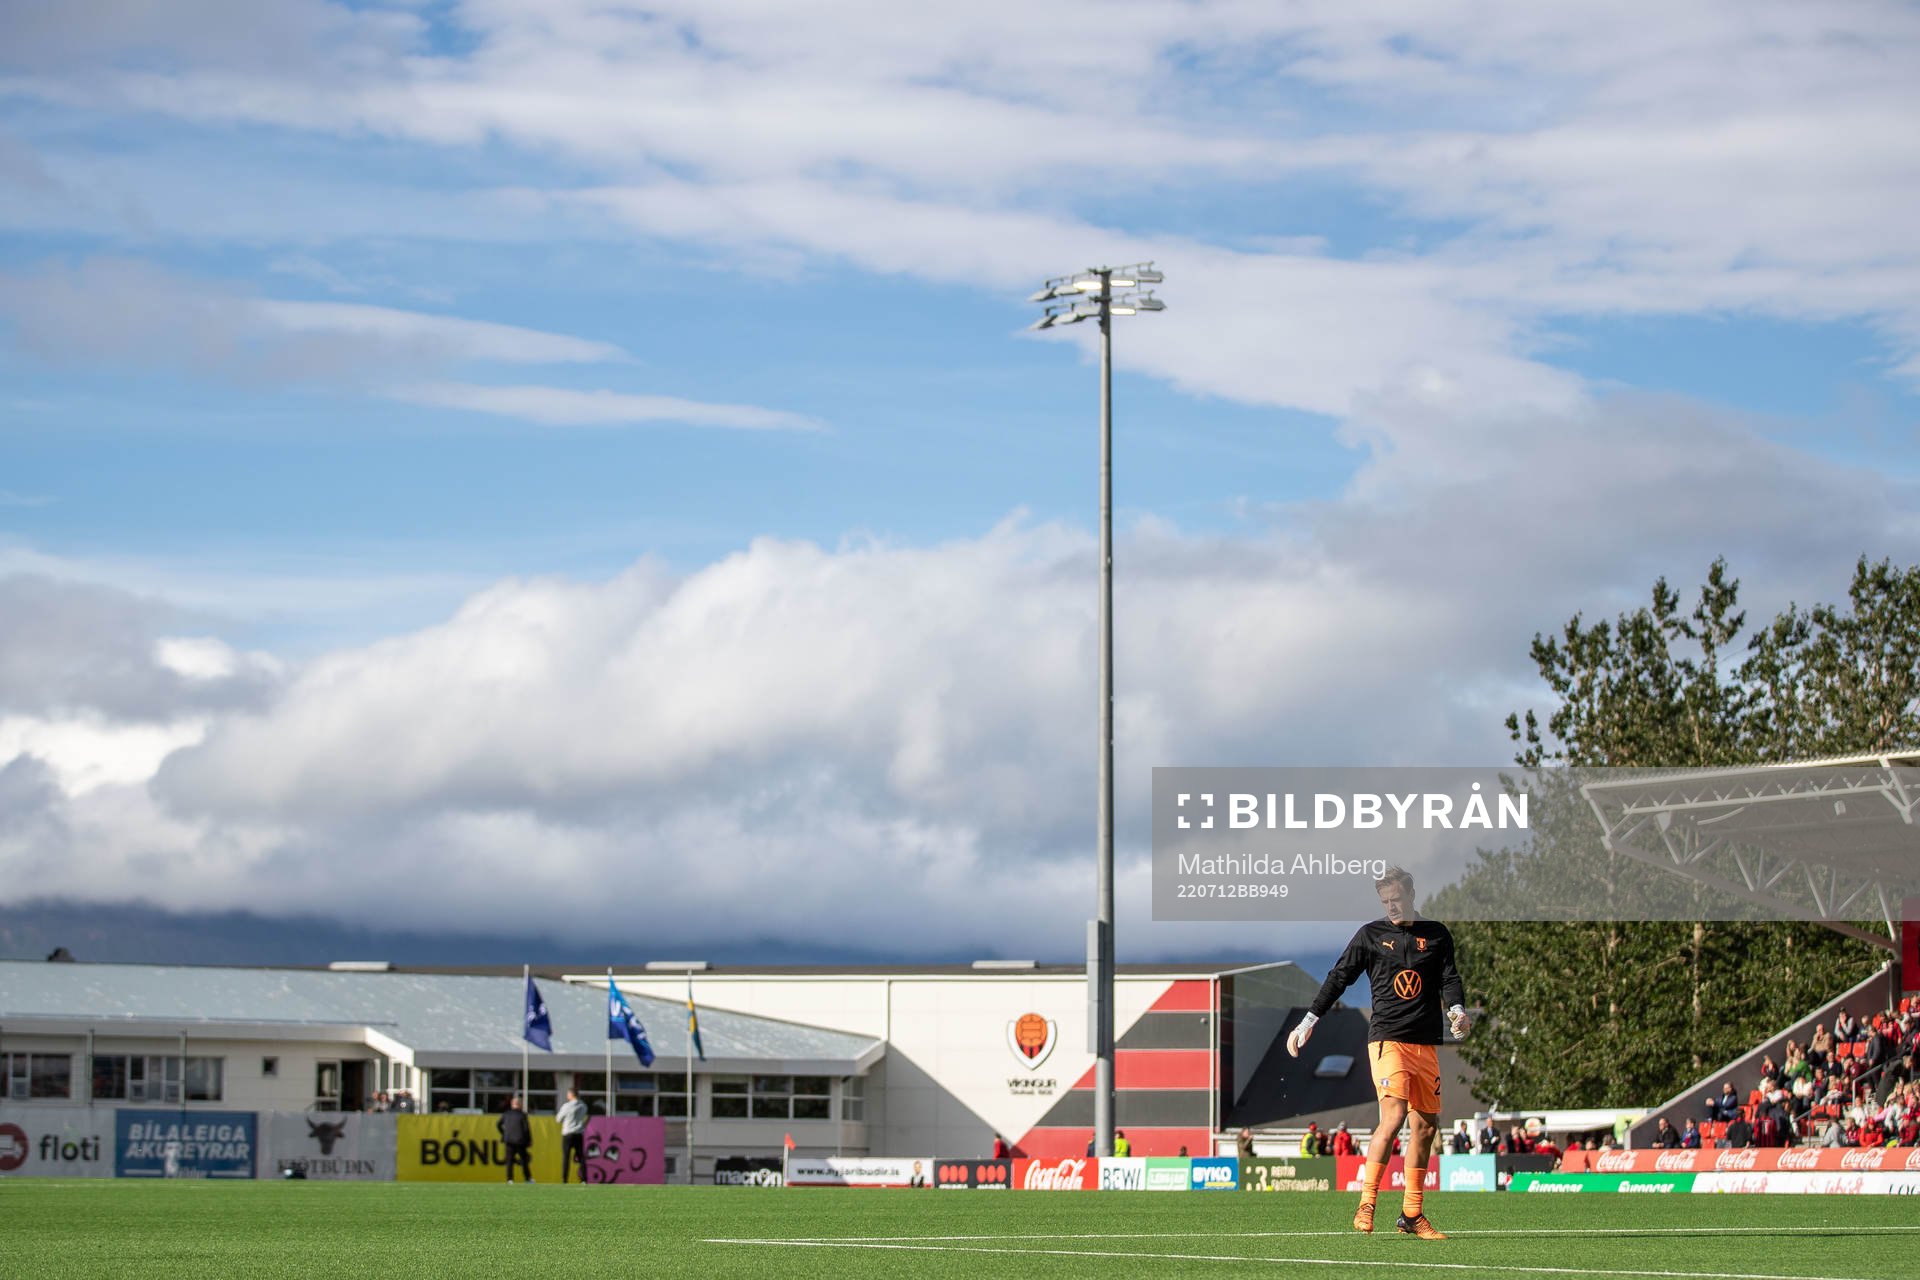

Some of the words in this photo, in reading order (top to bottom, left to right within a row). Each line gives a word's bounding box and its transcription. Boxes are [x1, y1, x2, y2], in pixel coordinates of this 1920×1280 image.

[128, 1119, 246, 1141] BÍLALEIGA
[39, 1133, 100, 1161] floti
[125, 1141, 250, 1159] AKUREYRAR
[420, 1131, 532, 1166] BÓNU
[716, 1168, 782, 1187] macron
[1192, 1166, 1232, 1183] BYKO
